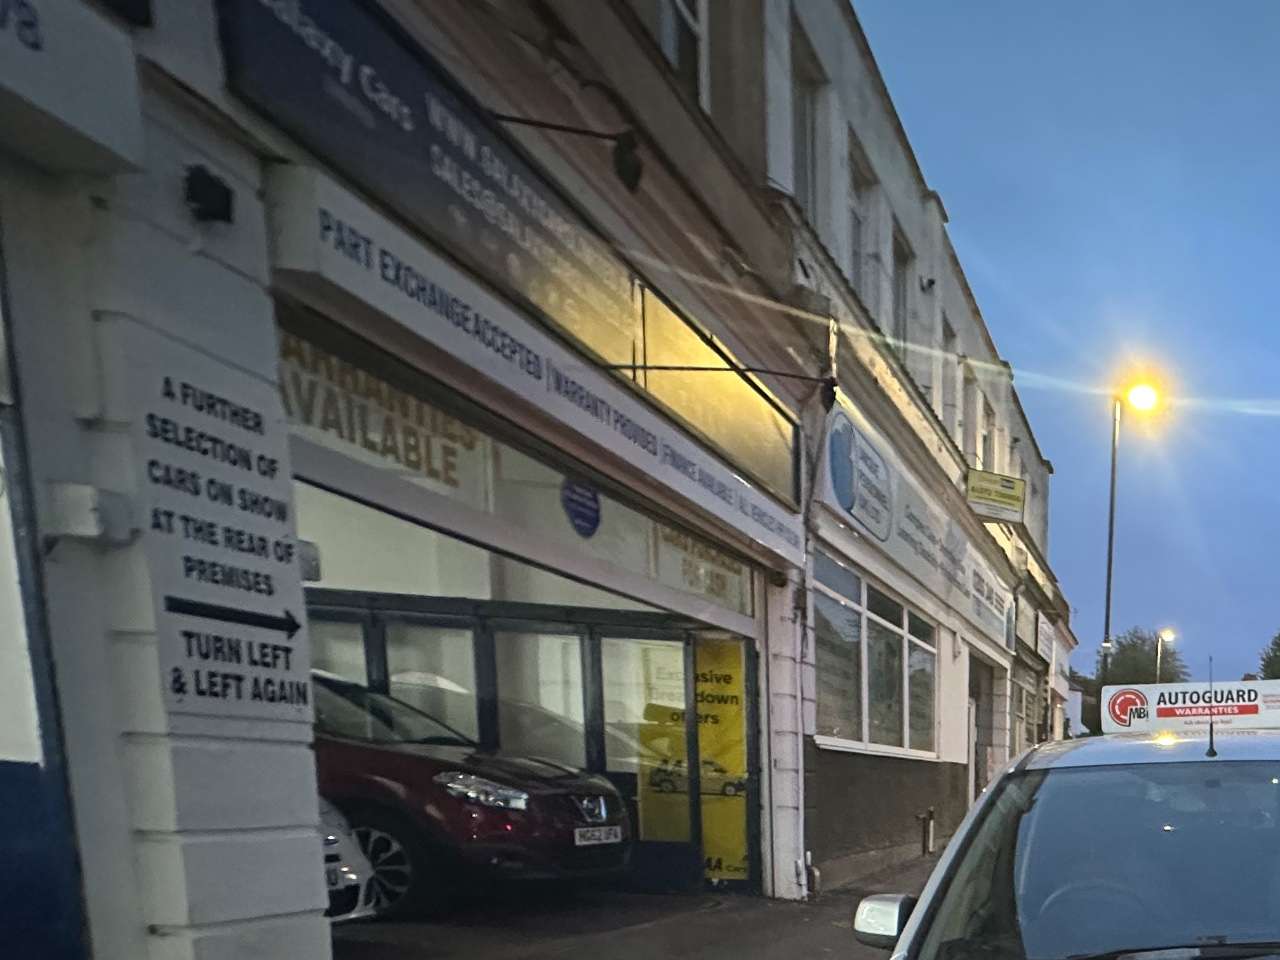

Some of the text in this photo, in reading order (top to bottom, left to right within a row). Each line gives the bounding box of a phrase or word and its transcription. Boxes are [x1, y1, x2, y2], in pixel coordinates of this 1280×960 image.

[318, 206, 373, 270] PART
[162, 376, 265, 436] A FURTHER
[146, 413, 279, 481] SELECTION OF
[147, 459, 288, 523] CARS ON SHOW
[150, 507, 295, 564] AT THE REAR OF
[183, 555, 275, 597] PREMISES
[181, 630, 294, 671] TURN LEFT
[171, 666, 308, 706] & LEFT AGAIN
[1156, 689, 1258, 706] AUTOGUARD
[1174, 705, 1240, 716] WARRANTIES
